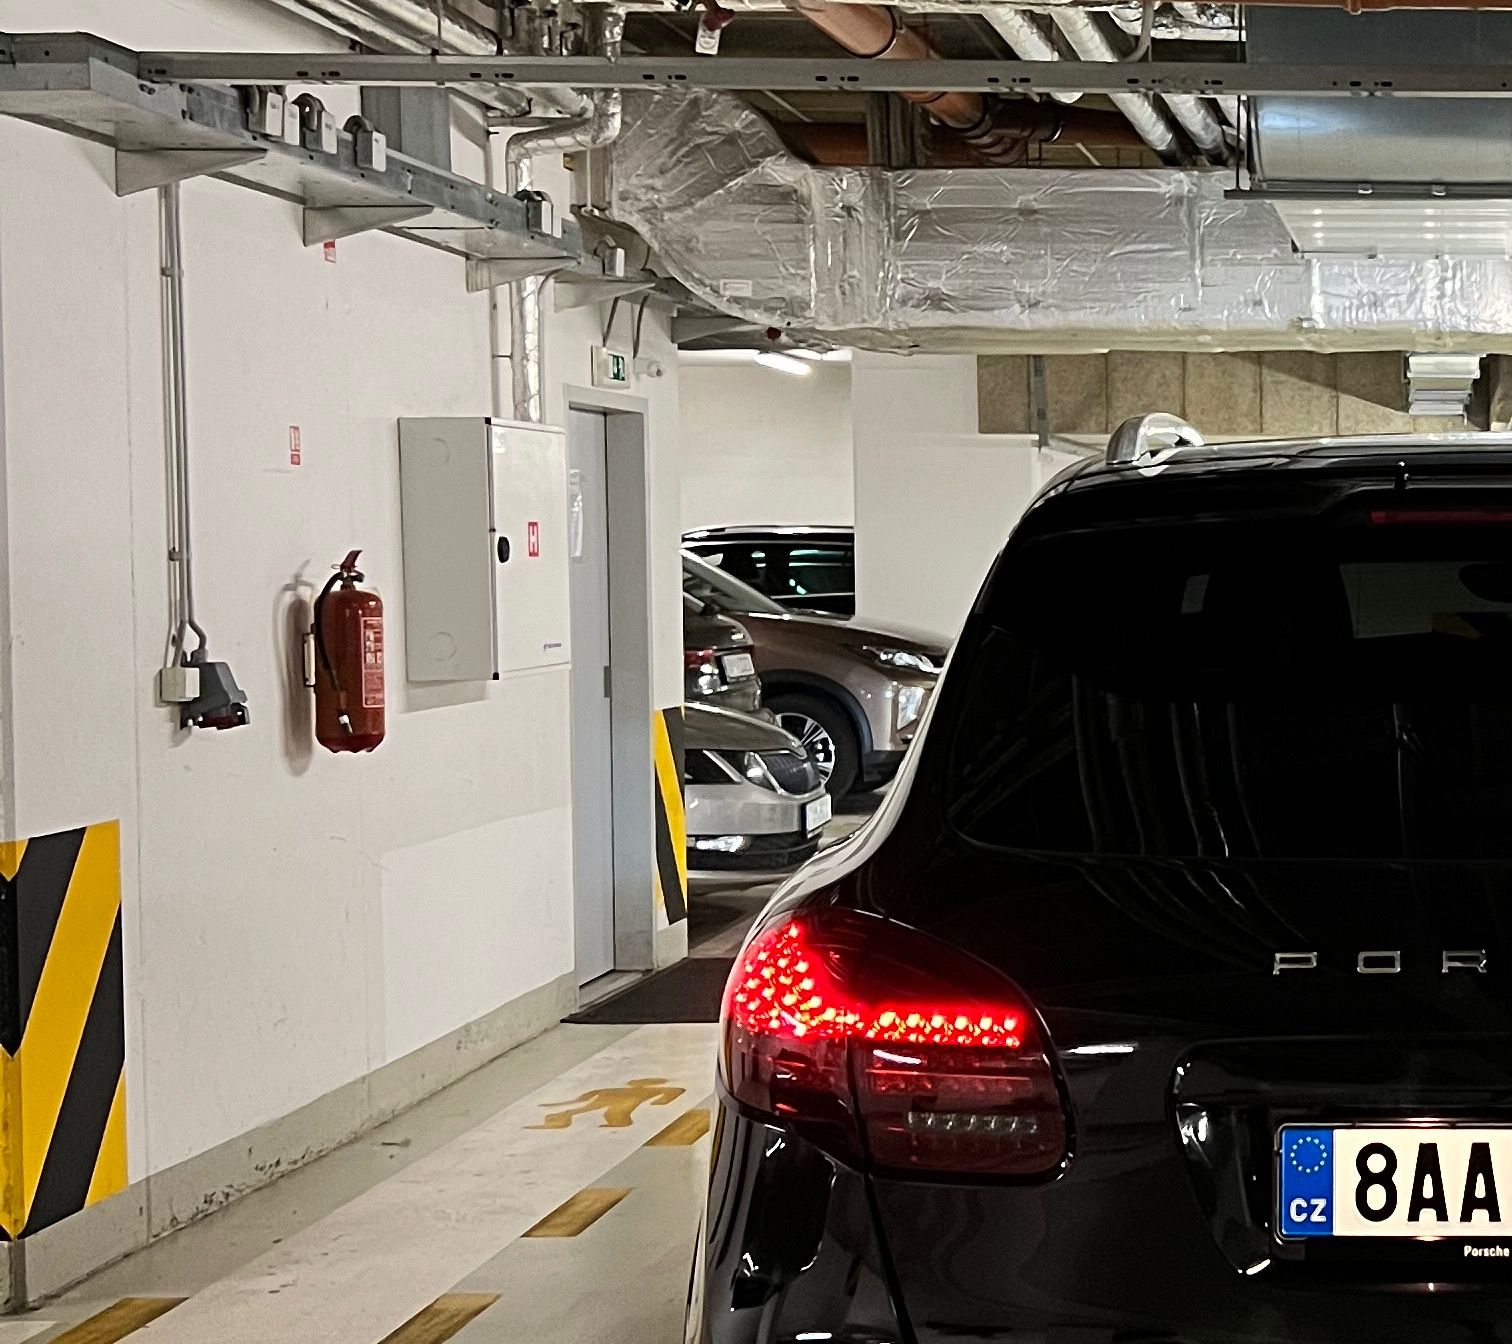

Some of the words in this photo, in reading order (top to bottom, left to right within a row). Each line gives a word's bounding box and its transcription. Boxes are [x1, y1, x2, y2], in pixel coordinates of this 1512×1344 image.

[1355, 1142, 1501, 1223] 8AA
[1290, 1197, 1327, 1223] CZ
[1463, 1245, 1510, 1257] Porsche
